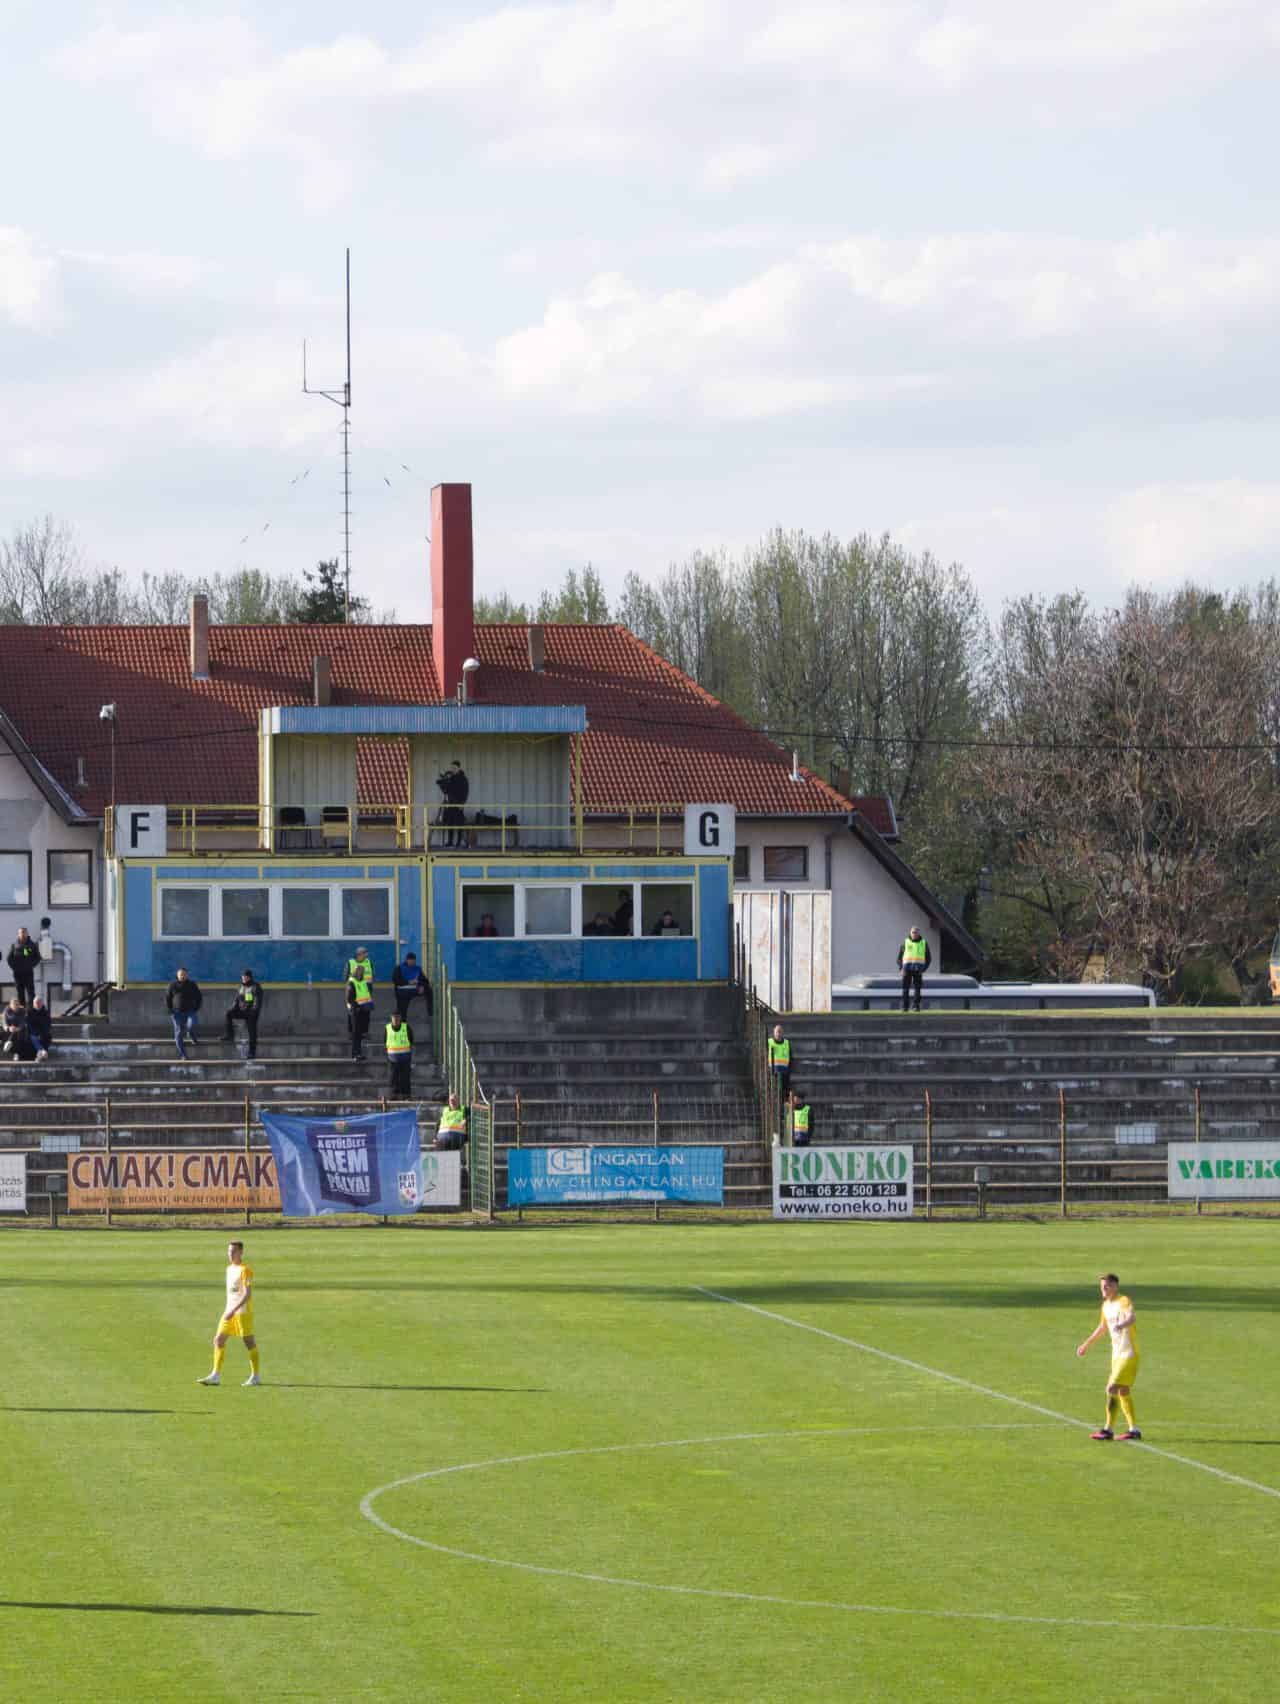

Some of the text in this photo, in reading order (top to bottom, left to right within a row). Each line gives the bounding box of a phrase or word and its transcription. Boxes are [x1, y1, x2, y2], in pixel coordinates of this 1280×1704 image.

[131, 812, 150, 848] F
[699, 812, 719, 847] G
[320, 1148, 368, 1173] NEM
[593, 1152, 684, 1165] INGATLAN
[779, 1151, 907, 1181] RONEKO
[72, 1155, 174, 1188] CMAK!
[326, 1172, 370, 1193] PÁLYA!
[817, 1185, 832, 1196] 06
[834, 1185, 849, 1196] 22
[852, 1185, 873, 1196] 500
[877, 1184, 897, 1195] 128
[780, 1199, 908, 1214] www.roneko.hu
